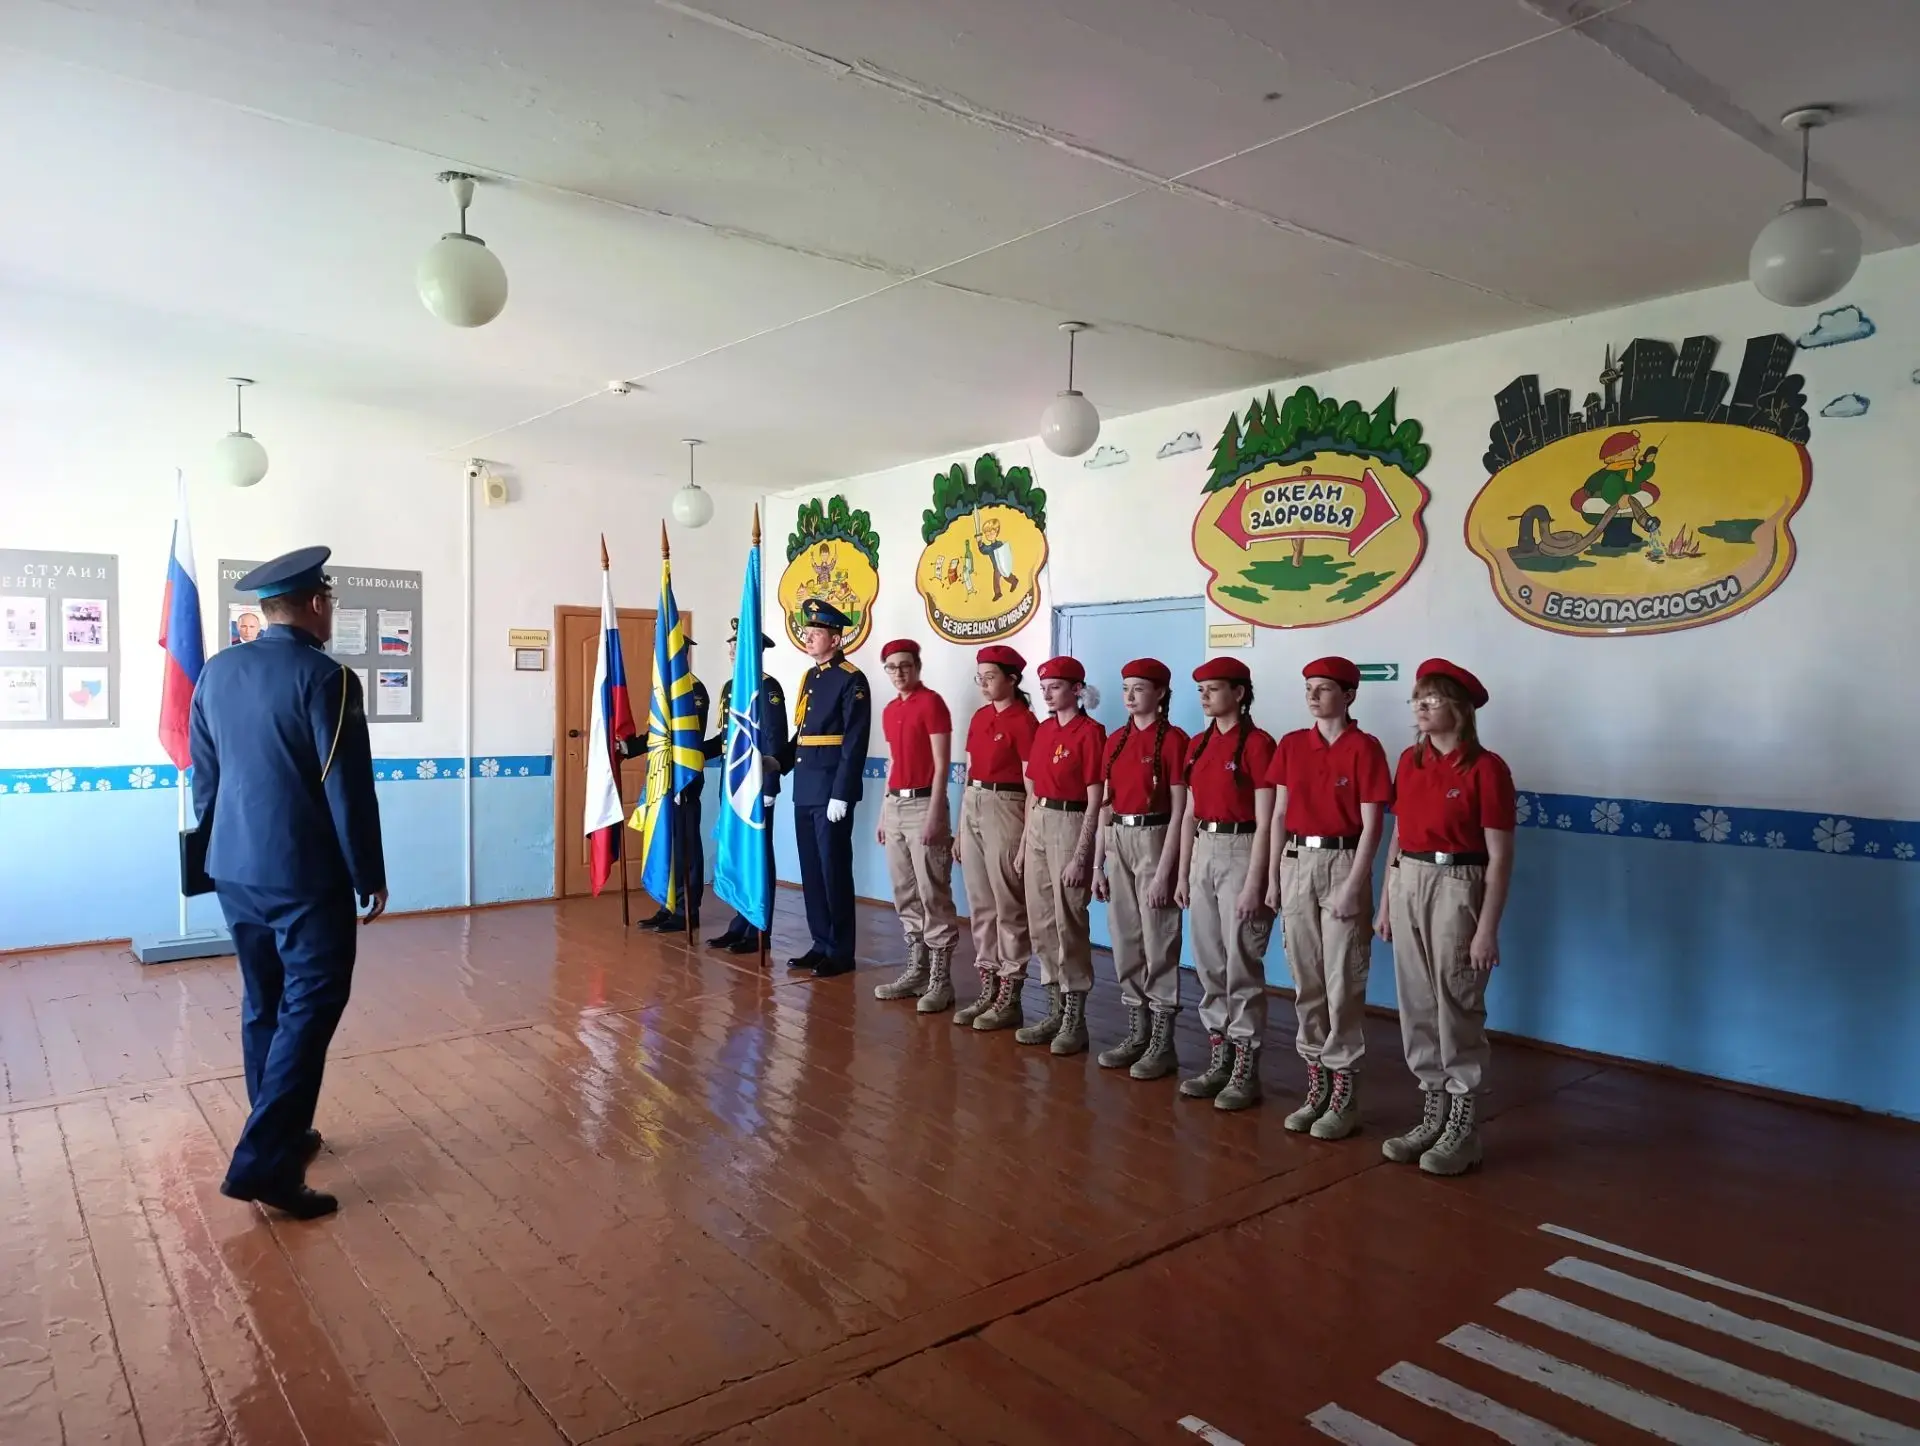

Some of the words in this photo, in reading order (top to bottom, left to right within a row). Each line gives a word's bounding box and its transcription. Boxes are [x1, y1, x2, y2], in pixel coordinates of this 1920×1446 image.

[1263, 483, 1342, 503] ОКЕАН
[1250, 503, 1354, 529] ЗДОРОВЬЯ
[347, 576, 420, 590] СИМВОЛИКА
[1545, 575, 1741, 622] БЕЗОПАСНОСТИ
[942, 615, 997, 635] БЕЗВРЕДНЫХ
